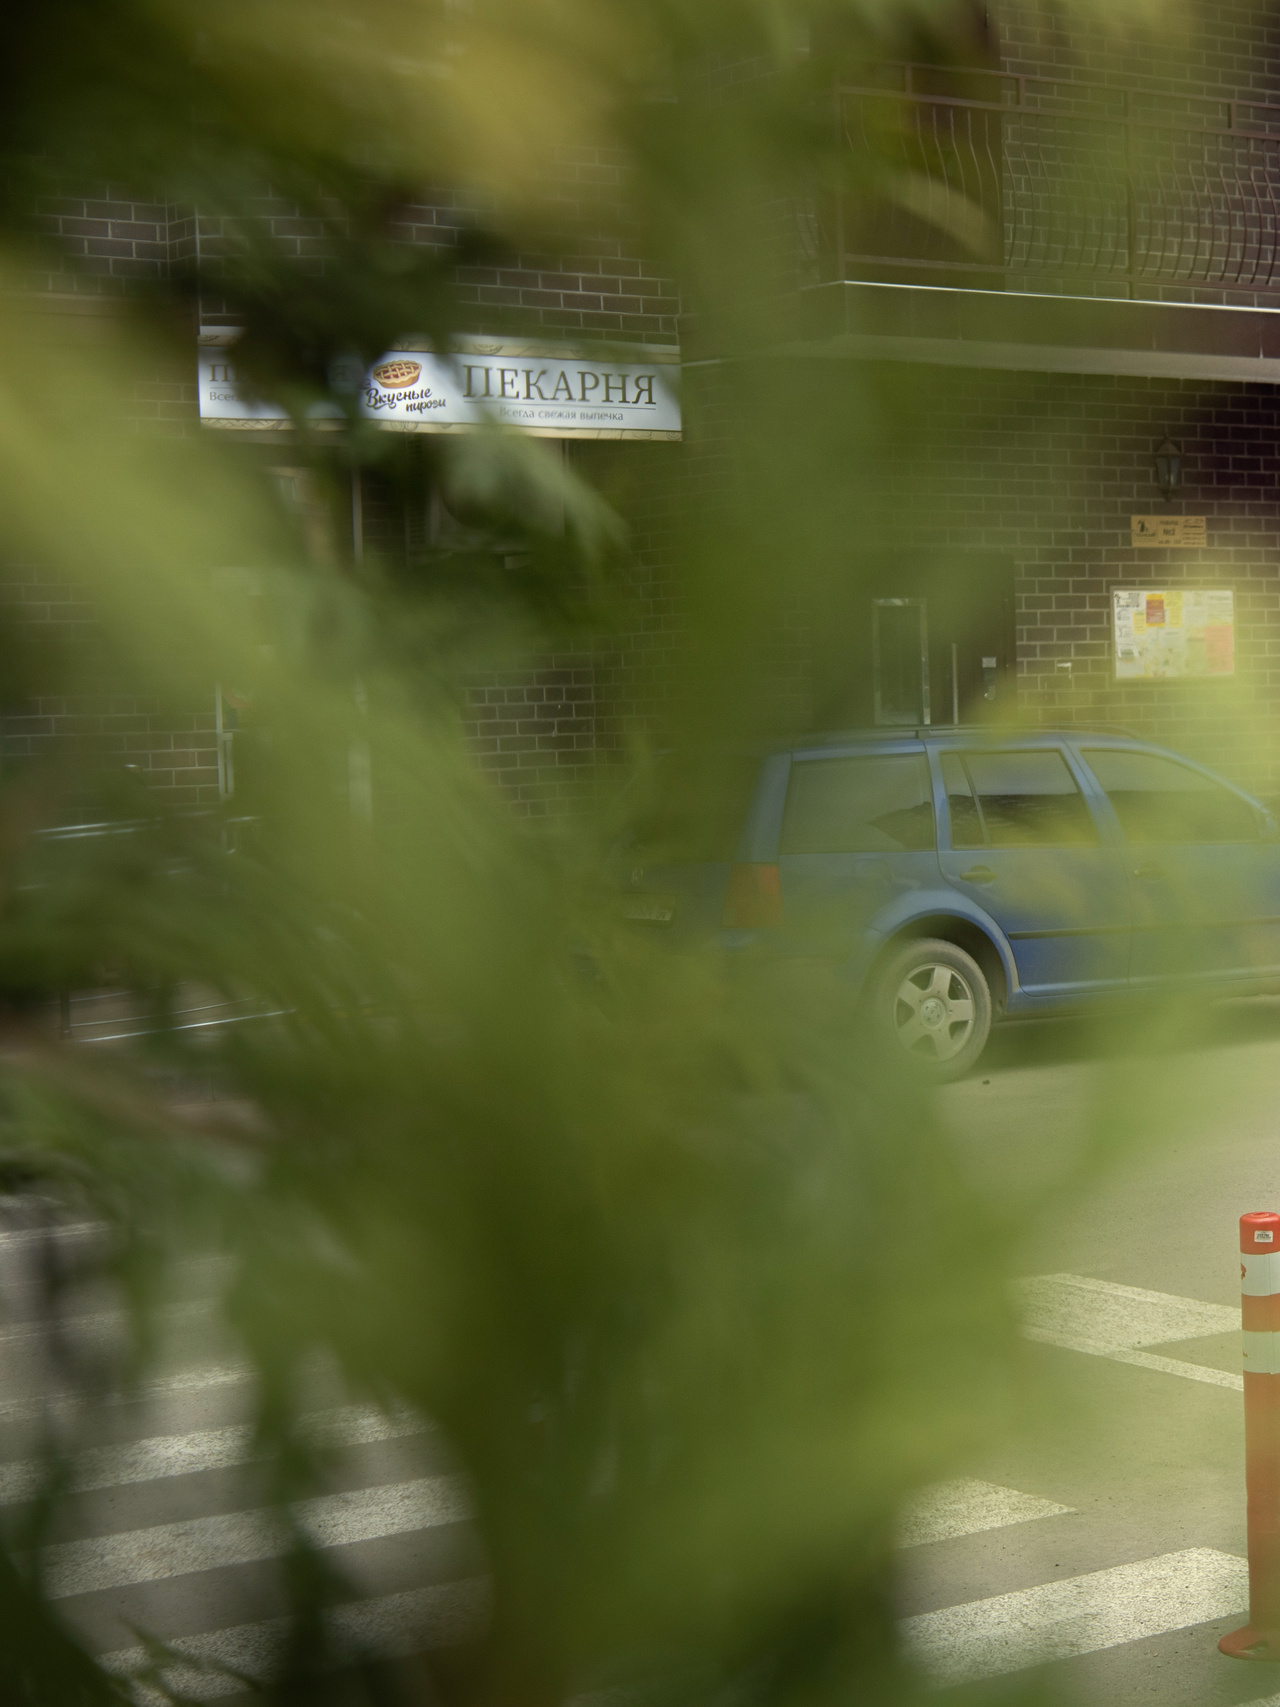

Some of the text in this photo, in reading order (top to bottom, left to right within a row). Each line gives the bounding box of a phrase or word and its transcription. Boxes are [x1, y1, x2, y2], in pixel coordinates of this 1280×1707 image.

[463, 365, 657, 405] ПЕКАРНЯ
[365, 387, 433, 410] Вкусные
[405, 398, 446, 414] пироги
[501, 407, 624, 421] Всегда свежая выпечка
